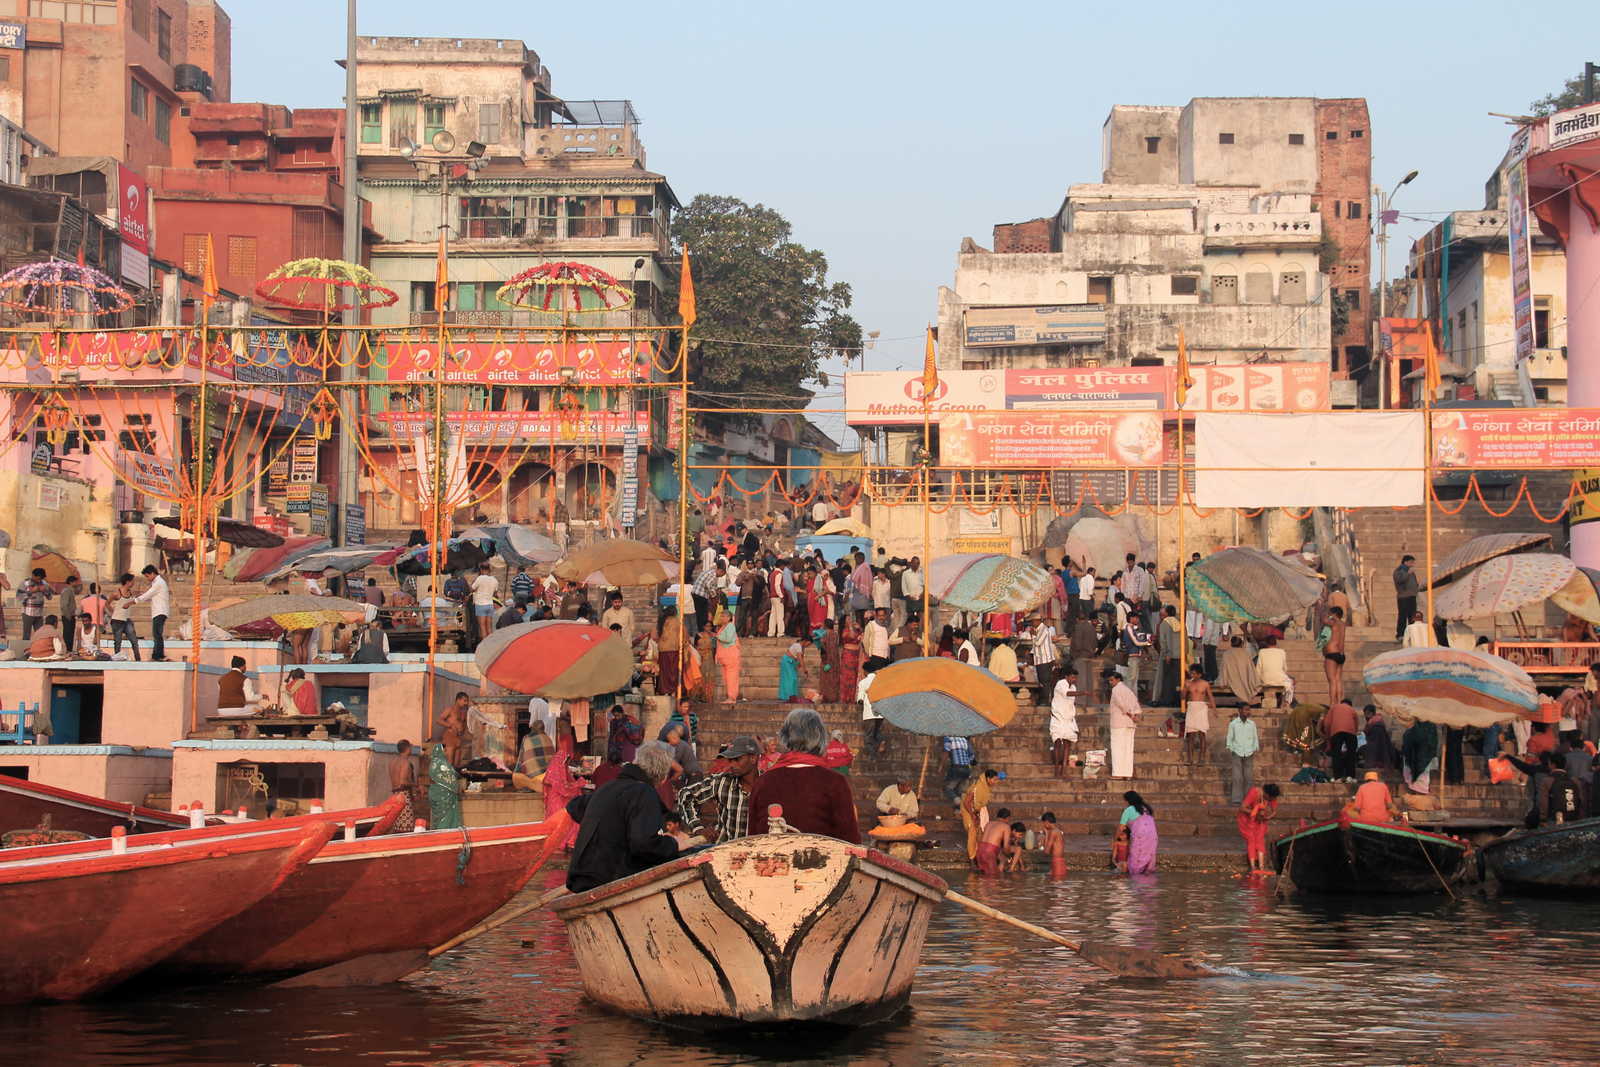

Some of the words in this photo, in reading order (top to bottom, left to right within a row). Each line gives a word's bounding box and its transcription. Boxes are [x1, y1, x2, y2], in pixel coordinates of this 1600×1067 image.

[123, 215, 146, 242] airtel
[447, 370, 478, 381] airtel
[487, 369, 519, 381] airtel
[528, 369, 559, 381] airtel
[1019, 374, 1067, 387] जल
[1073, 370, 1151, 389] पुलिस
[977, 420, 1015, 436] गंगा
[1020, 420, 1055, 436] सेवा
[1059, 420, 1113, 437] समिति
[1472, 418, 1511, 433] गंगा
[1517, 417, 1554, 433] सेवा
